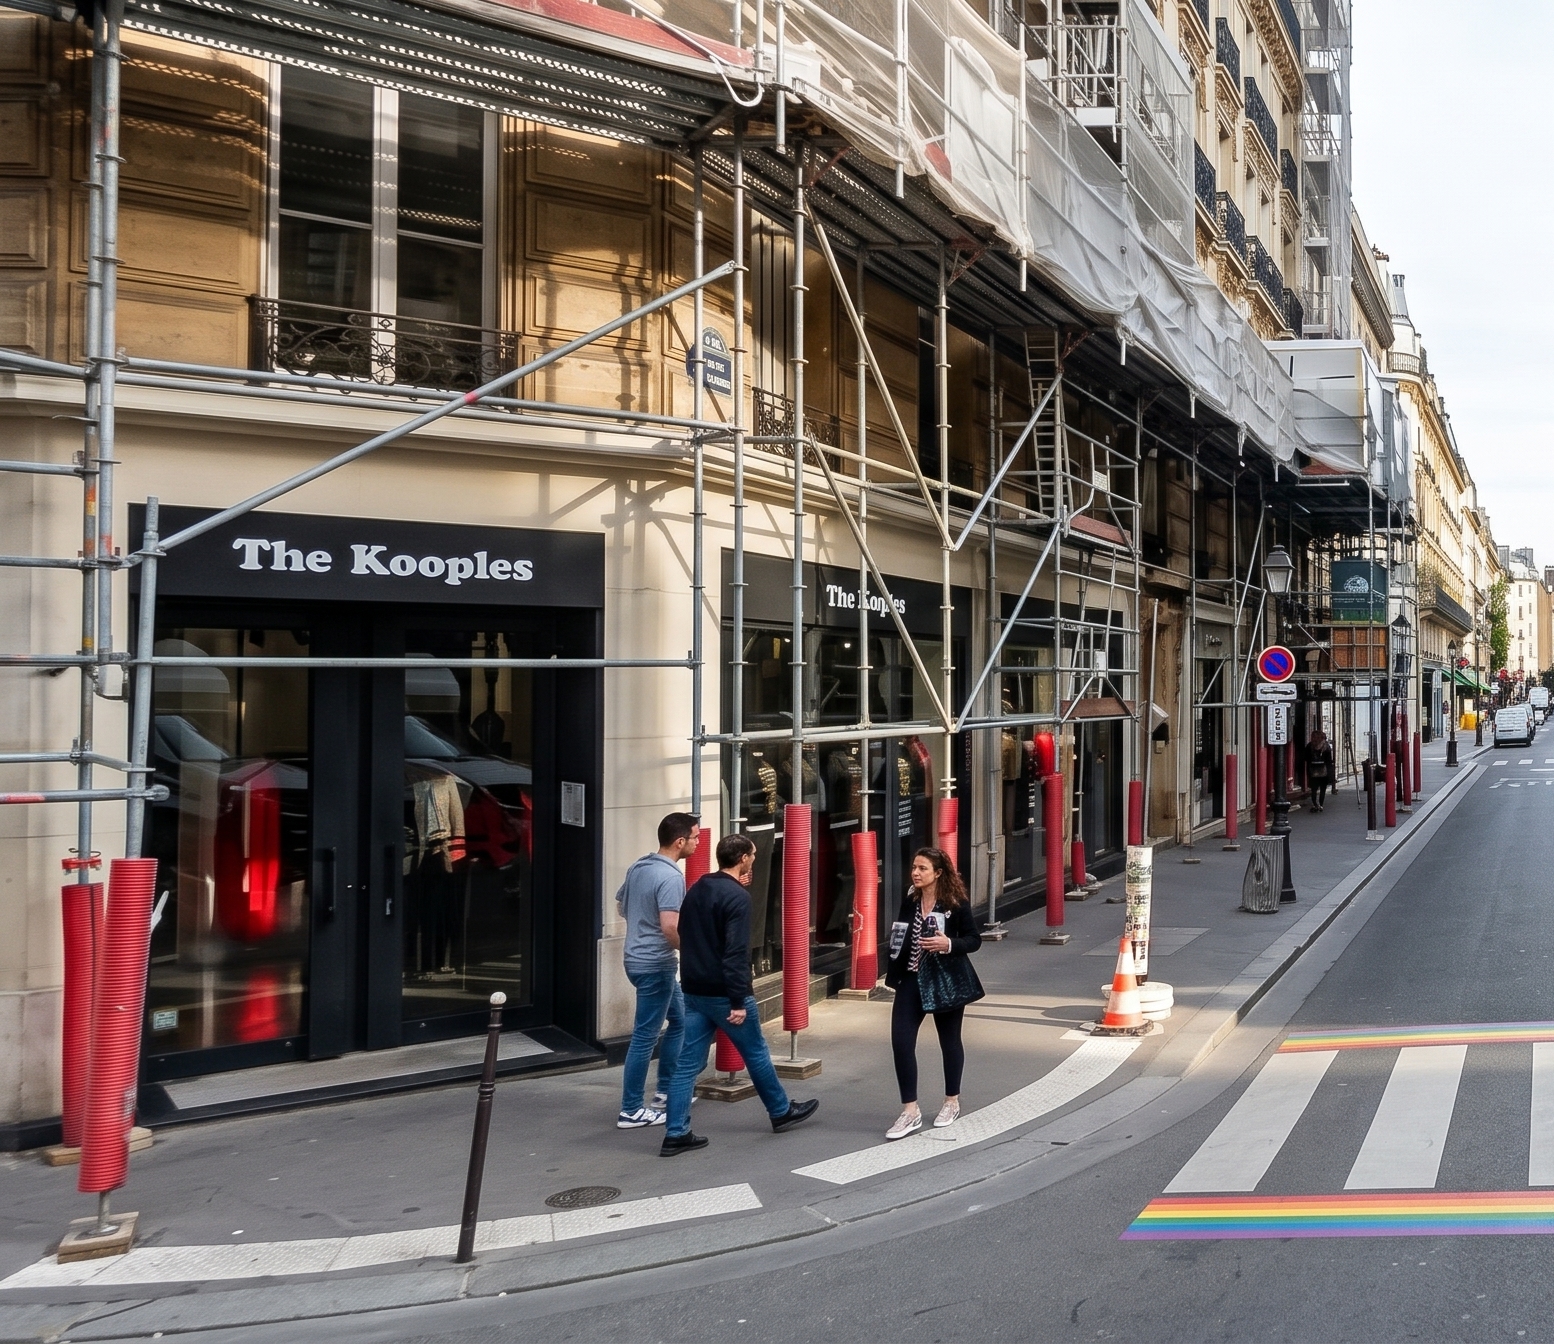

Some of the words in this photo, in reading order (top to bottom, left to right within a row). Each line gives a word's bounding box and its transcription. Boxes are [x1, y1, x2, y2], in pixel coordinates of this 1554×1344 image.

[232, 538, 332, 573] The
[350, 544, 534, 586] Kooples
[826, 584, 855, 609] The
